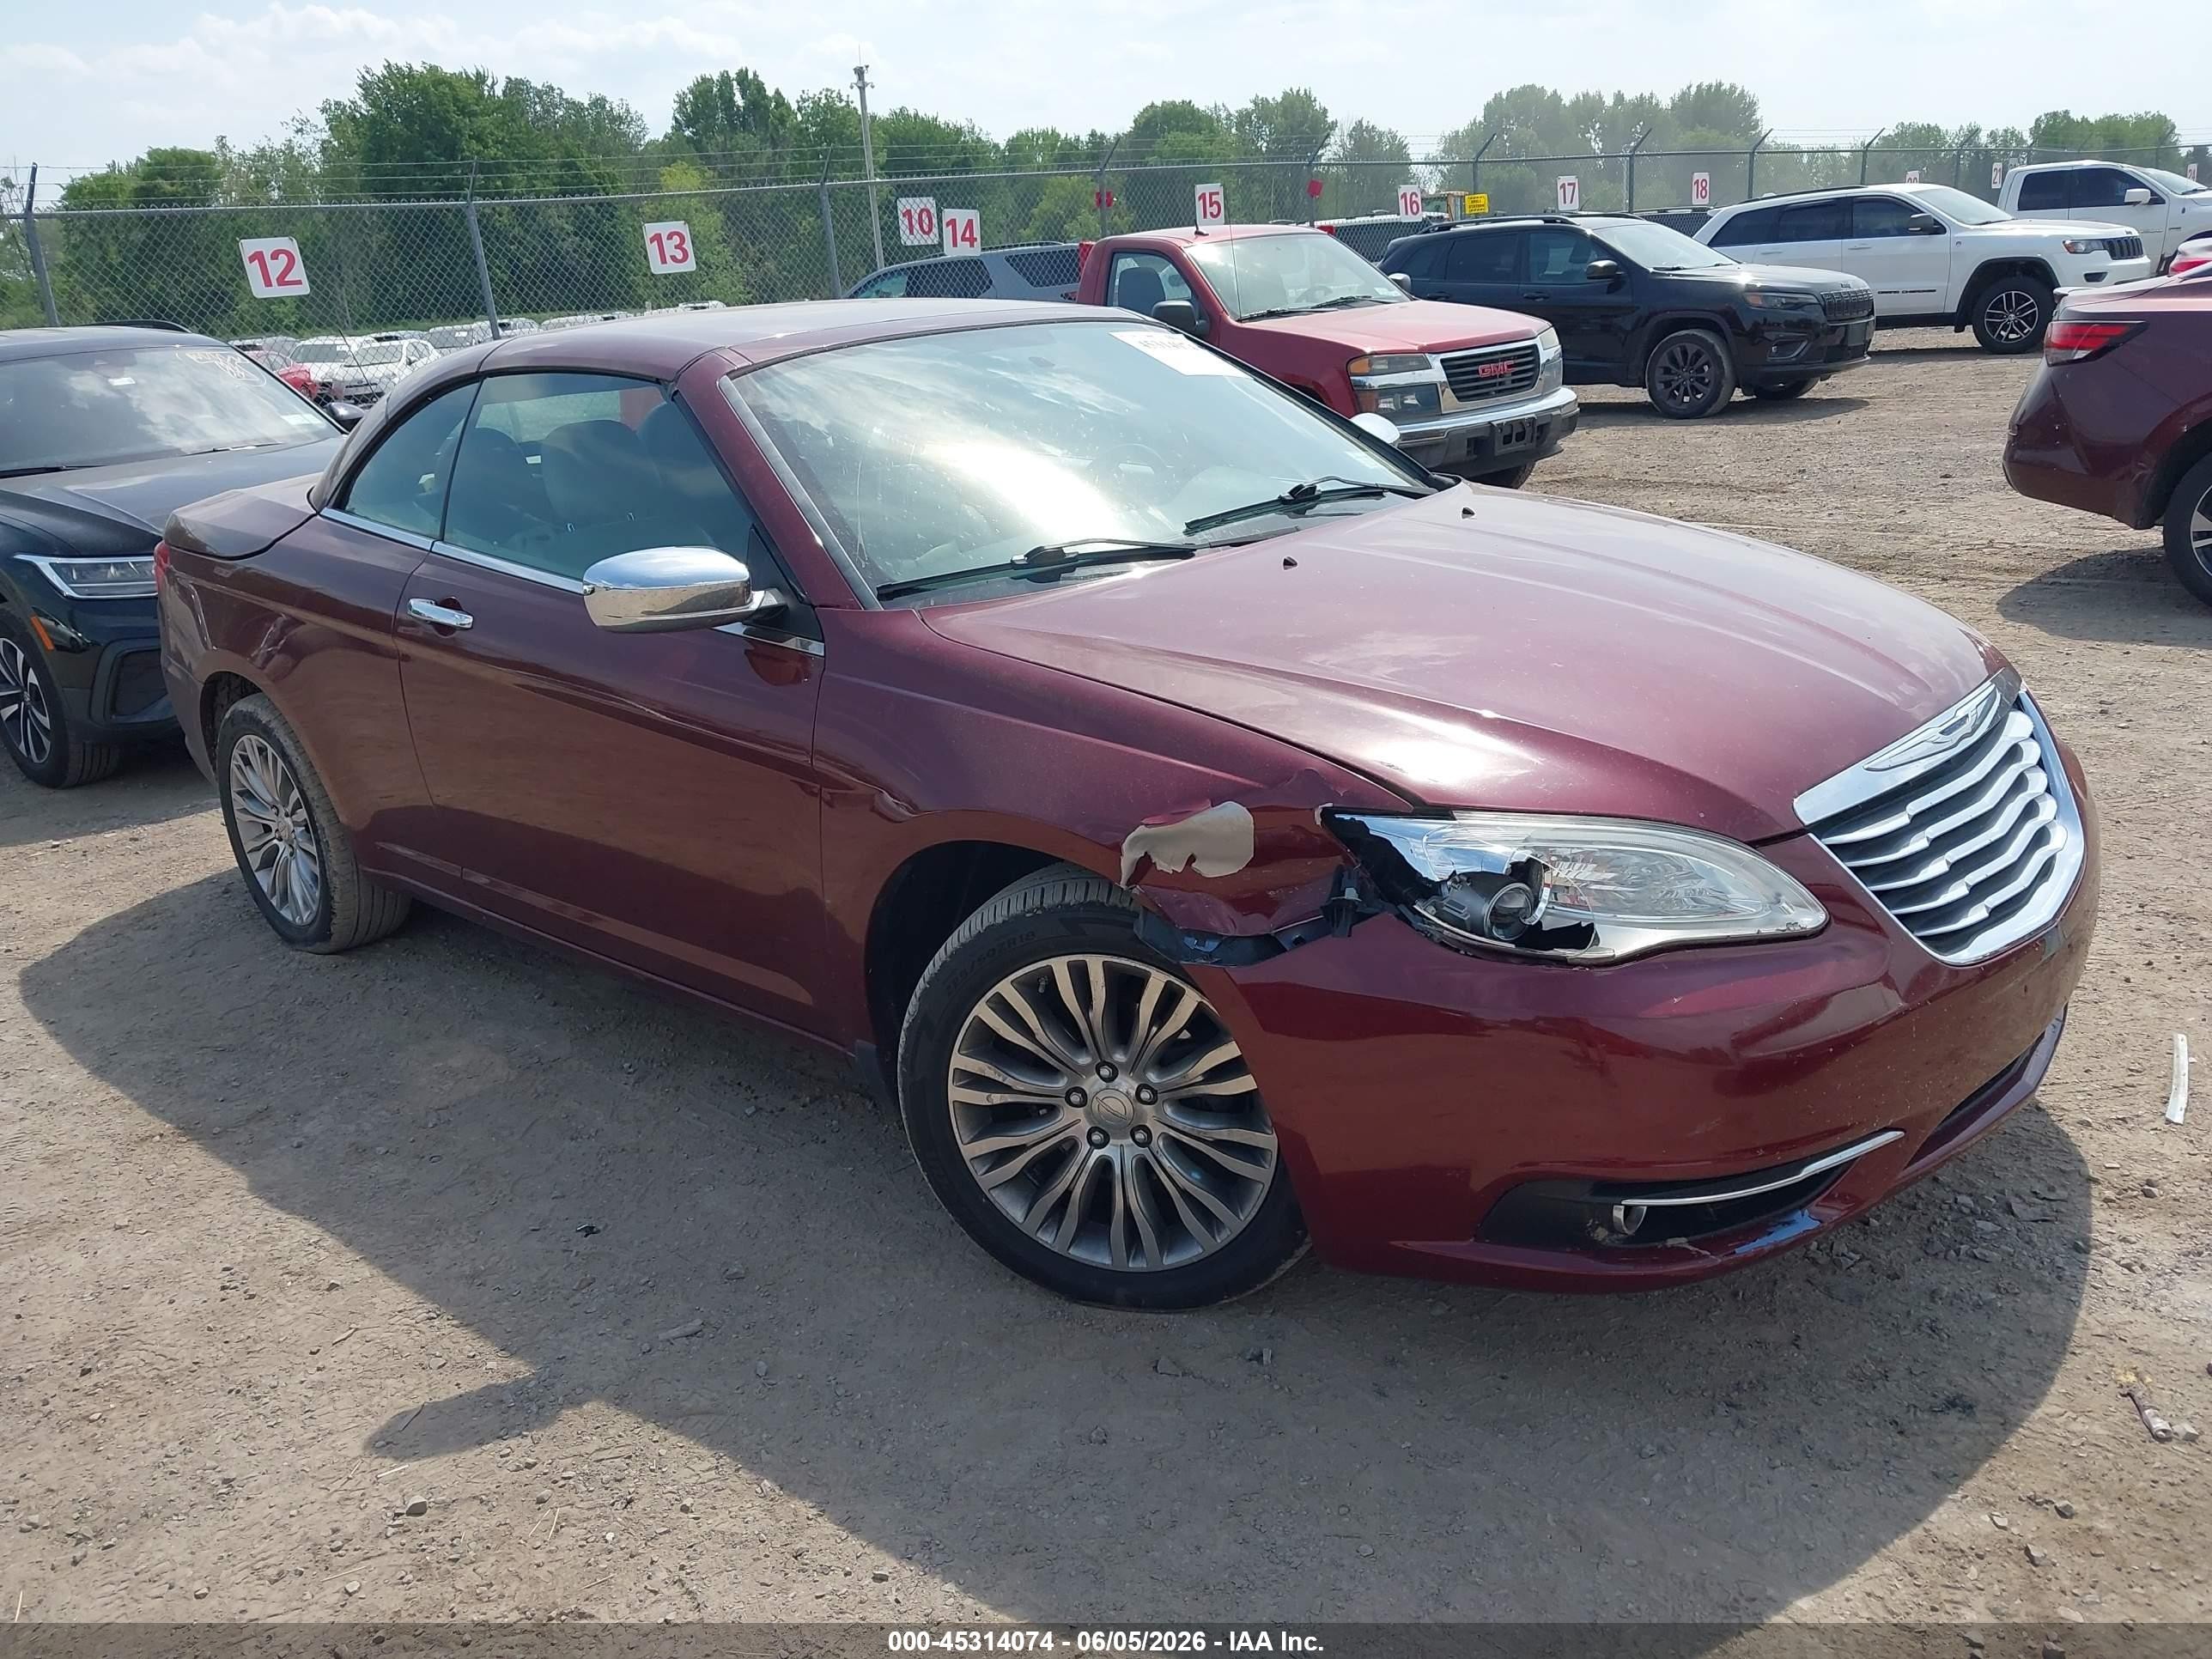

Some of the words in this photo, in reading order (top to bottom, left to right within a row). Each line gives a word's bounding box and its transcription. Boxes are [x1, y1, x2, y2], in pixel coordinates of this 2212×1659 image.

[1693, 179, 1708, 199] 18
[1992, 167, 2002, 185] 21
[1199, 192, 1222, 220] 15
[1401, 191, 1419, 216] 16
[1559, 182, 1577, 204] 17
[902, 208, 933, 235] 10
[945, 218, 977, 247] 14
[649, 231, 690, 264] 13
[248, 249, 302, 289] 12
[1478, 361, 1518, 378] GMC
